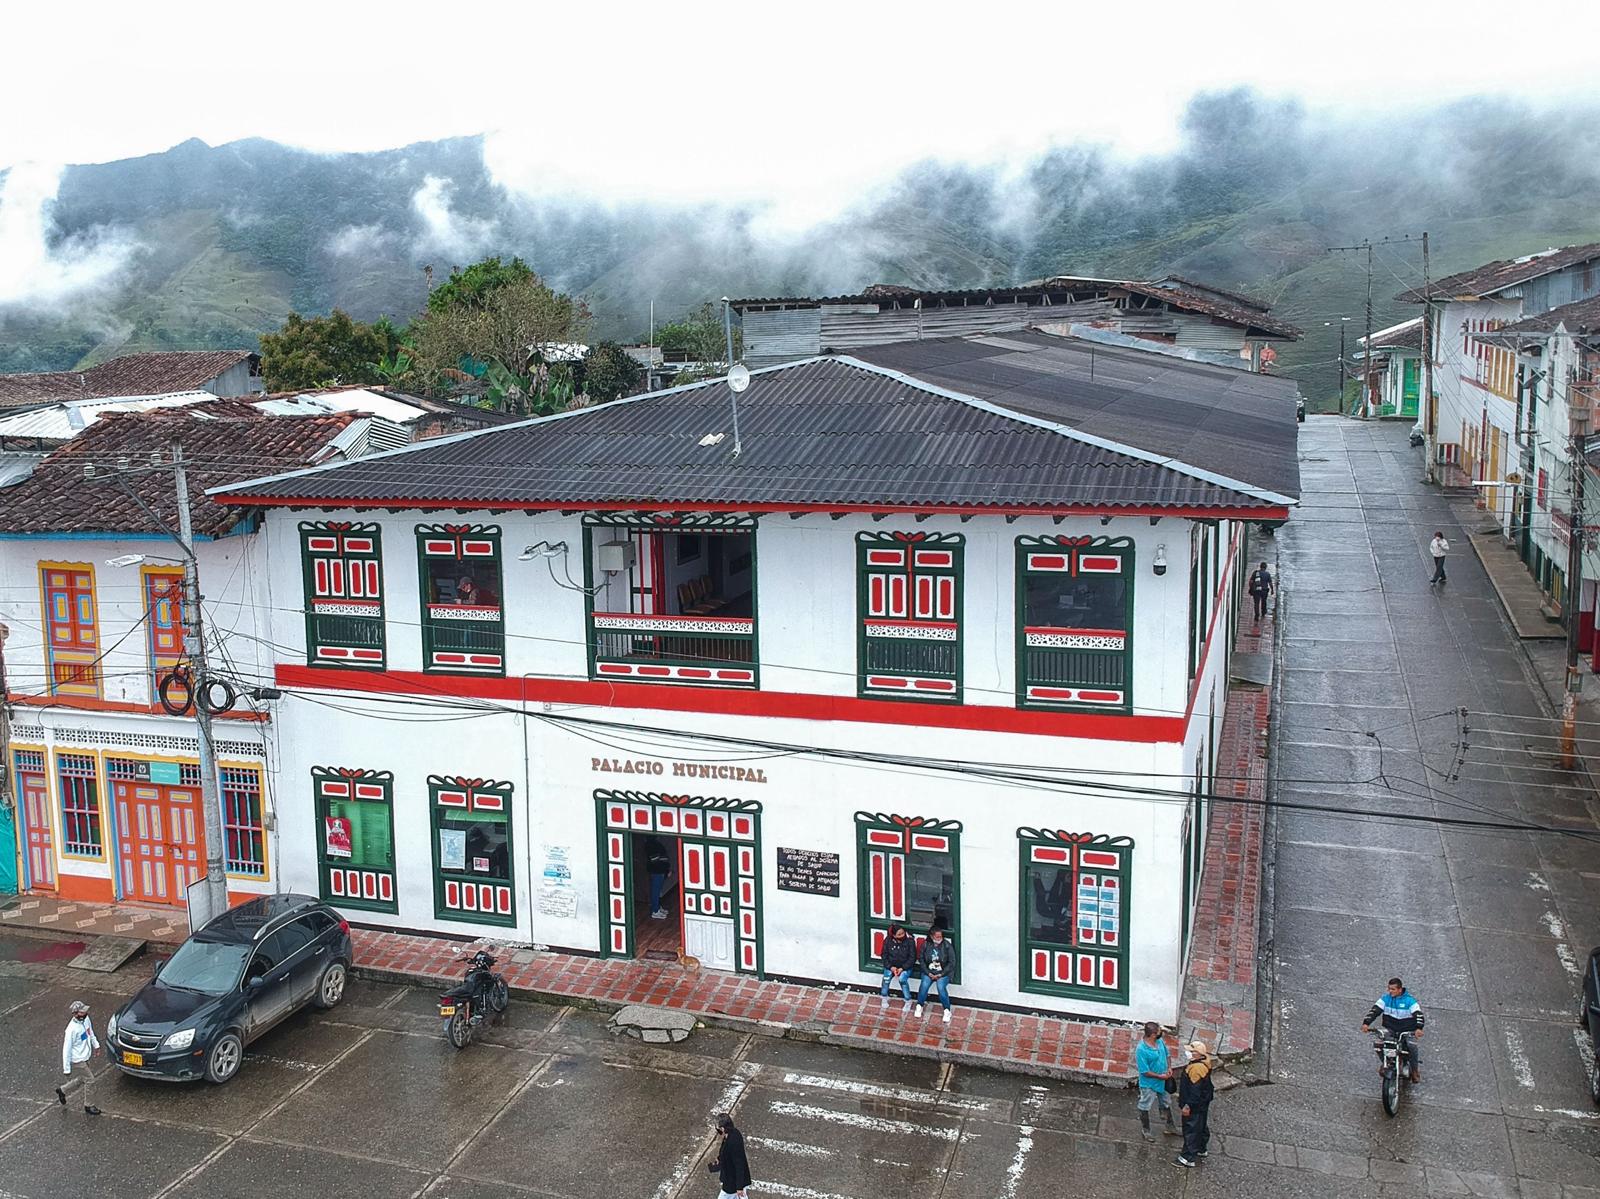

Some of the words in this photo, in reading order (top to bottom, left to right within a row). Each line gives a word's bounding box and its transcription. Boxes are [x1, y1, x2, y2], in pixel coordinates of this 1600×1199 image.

[591, 757, 664, 775] PALACIO
[672, 762, 768, 783] MUNICIPAL
[789, 880, 807, 888] SISTEMA
